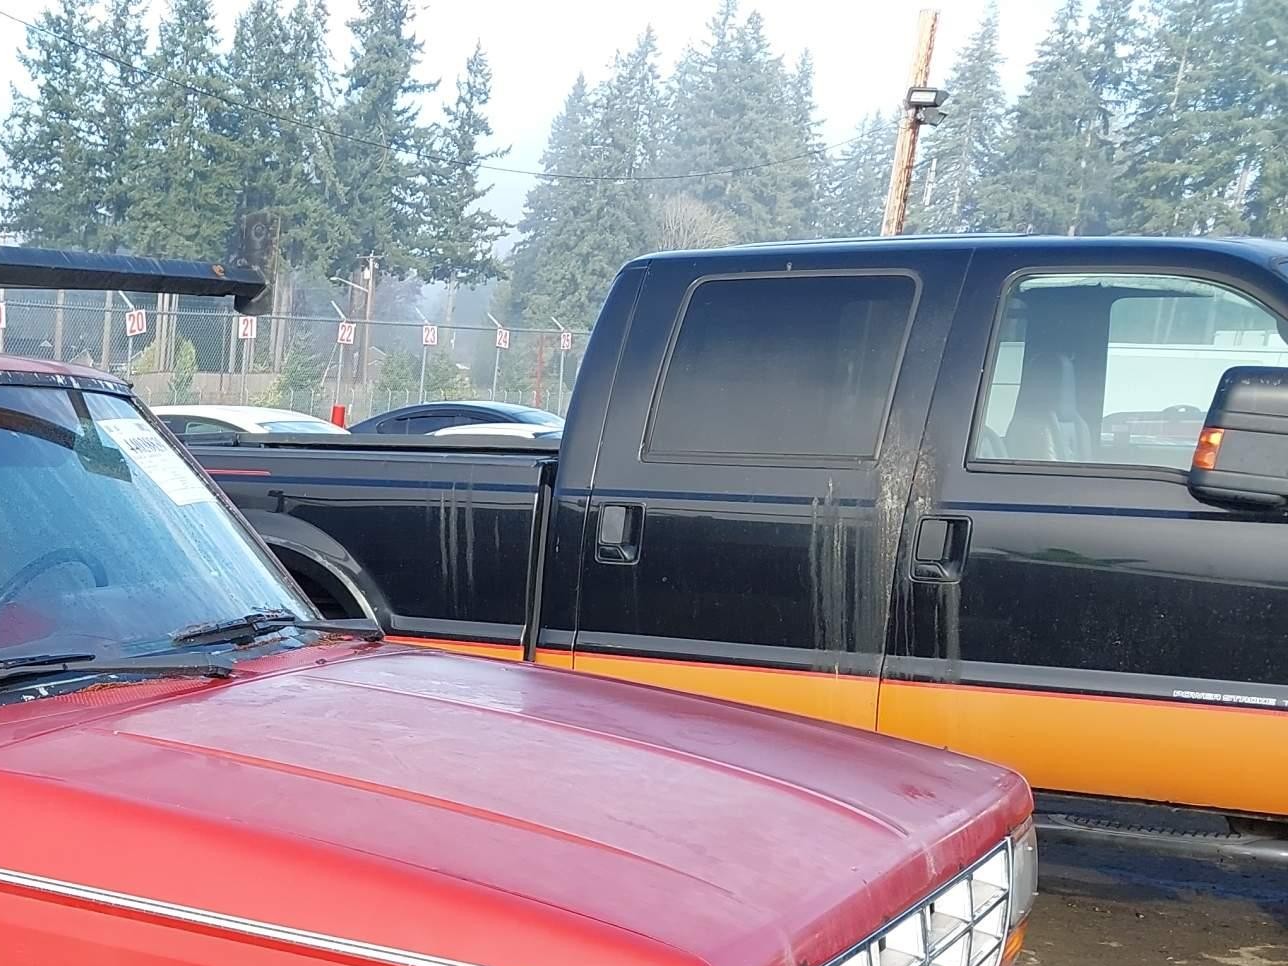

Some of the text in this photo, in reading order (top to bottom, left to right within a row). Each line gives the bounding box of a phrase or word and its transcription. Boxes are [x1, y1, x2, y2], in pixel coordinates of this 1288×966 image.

[128, 310, 145, 334] 20
[242, 318, 253, 337] 21
[340, 325, 353, 342] 22
[424, 326, 436, 343] 23
[498, 329, 508, 347] 24
[562, 333, 571, 349] 25
